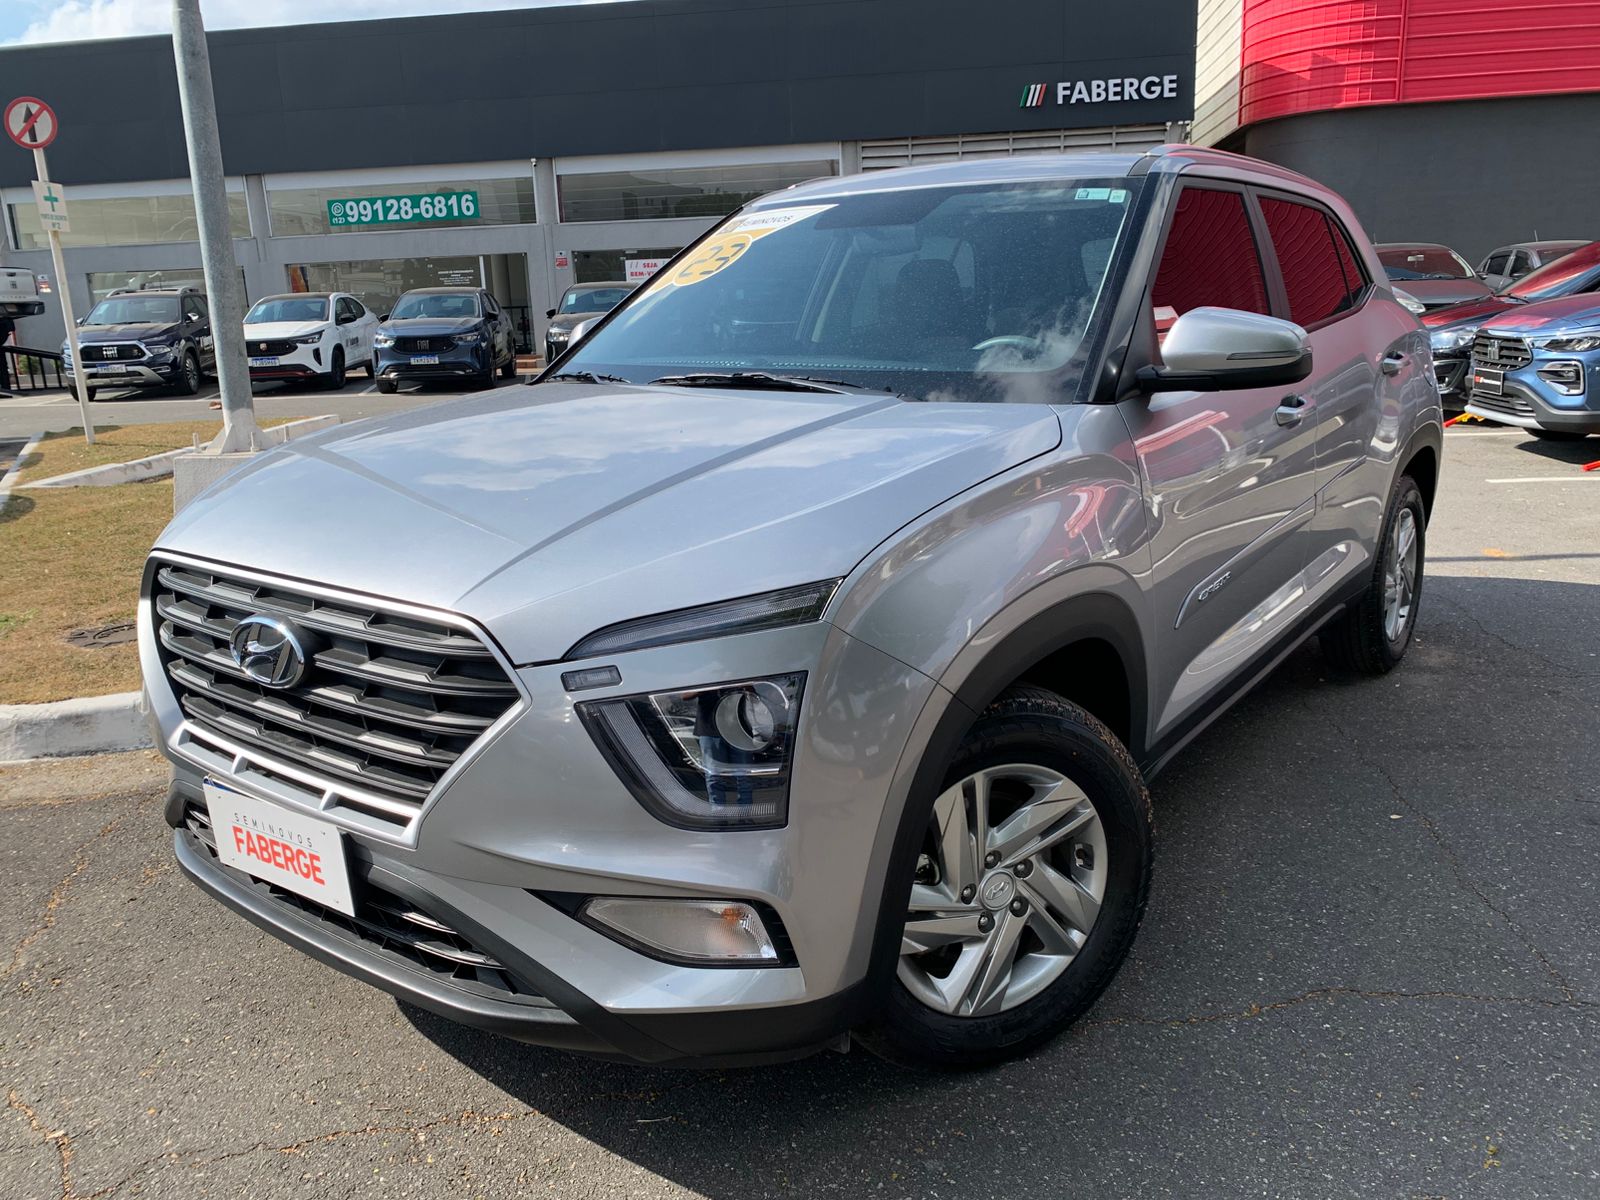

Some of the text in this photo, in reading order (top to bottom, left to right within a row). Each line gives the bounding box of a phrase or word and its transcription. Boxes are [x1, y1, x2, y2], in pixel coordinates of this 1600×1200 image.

[1056, 74, 1178, 105] FABERGE
[345, 194, 475, 223] 99128-6816
[102, 346, 118, 359] FIAT
[416, 339, 430, 351] FIAT
[234, 812, 313, 848] SEMINOVOS
[232, 825, 326, 886] FABERGE
